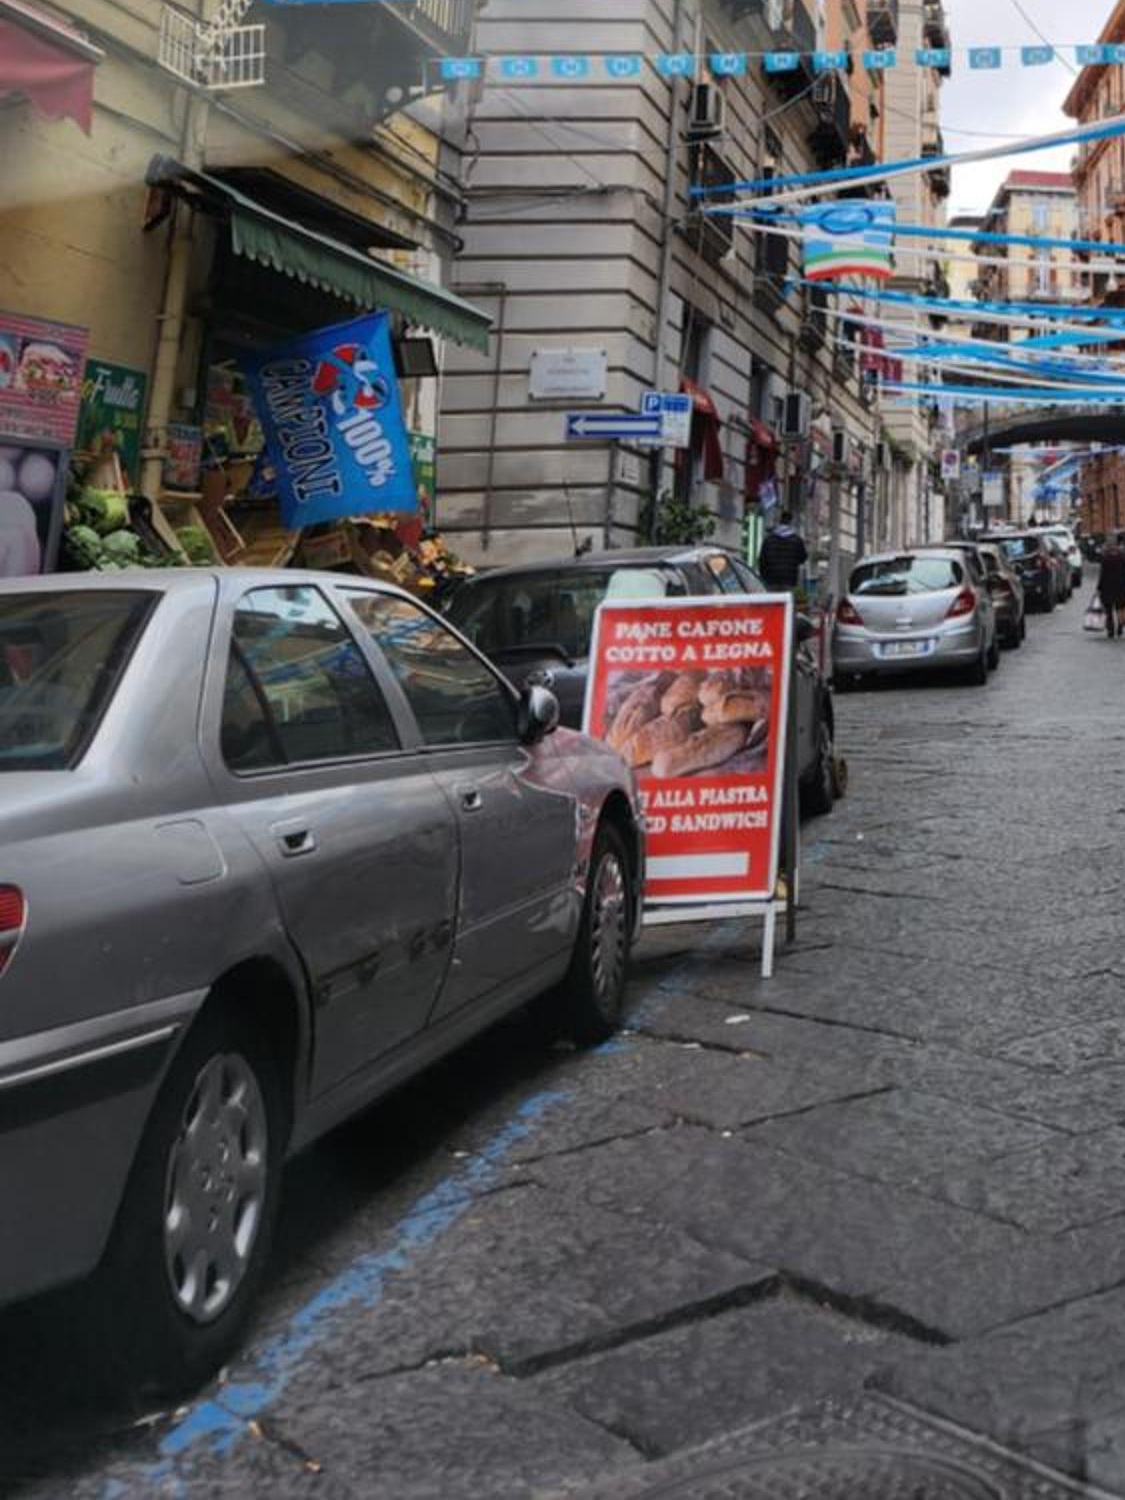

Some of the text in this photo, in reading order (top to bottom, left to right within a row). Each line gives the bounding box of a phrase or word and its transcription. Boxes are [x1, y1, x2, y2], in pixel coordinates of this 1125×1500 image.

[260, 358, 344, 503] CAMPIONI
[336, 409, 397, 488] 100%
[615, 618, 764, 639] PANE CAFONE
[605, 642, 774, 663] COTTO A LEGNA
[652, 788, 695, 808] ALLA
[700, 785, 769, 806] PIASTRA
[670, 809, 769, 833] SANDWICH
